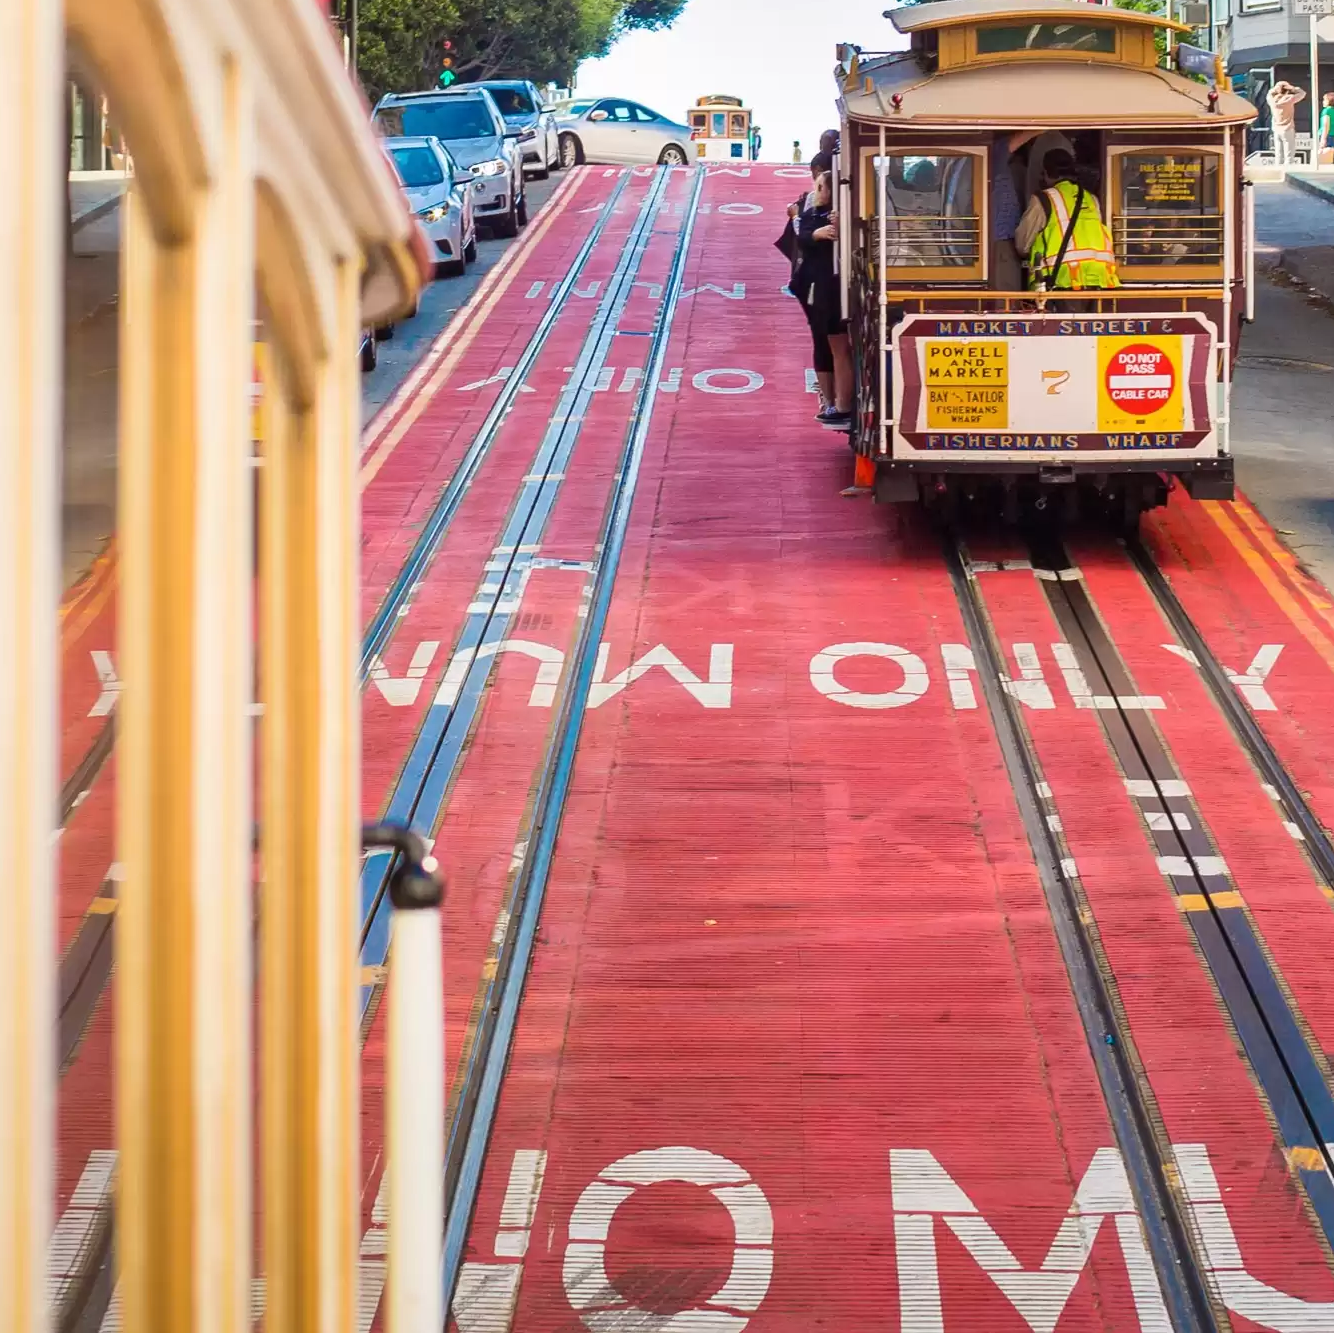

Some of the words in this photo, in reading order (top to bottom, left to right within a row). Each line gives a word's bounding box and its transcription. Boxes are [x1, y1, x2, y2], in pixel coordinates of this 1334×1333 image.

[1303, 4, 1325, 13] PASS
[937, 321, 1033, 336] MARKET
[1059, 320, 1151, 335] STREET
[931, 347, 1003, 358] POWELL
[950, 358, 985, 367] AND
[1118, 353, 1136, 364] DO
[1137, 353, 1163, 364] NOT
[929, 368, 1004, 378] MARKET
[1125, 364, 1155, 374] PASS
[1041, 370, 1070, 395] 7
[930, 391, 949, 403] BAY
[966, 391, 1005, 403] TAYLOR
[1112, 390, 1146, 400] CABLE
[1147, 389, 1169, 399] CAR
[936, 406, 998, 414] FISHERMANS
[951, 415, 983, 423] WHARF
[926, 434, 1079, 450] FISHERMANS
[1105, 433, 1184, 449] WHARF
[809, 641, 1285, 711] ONLY
